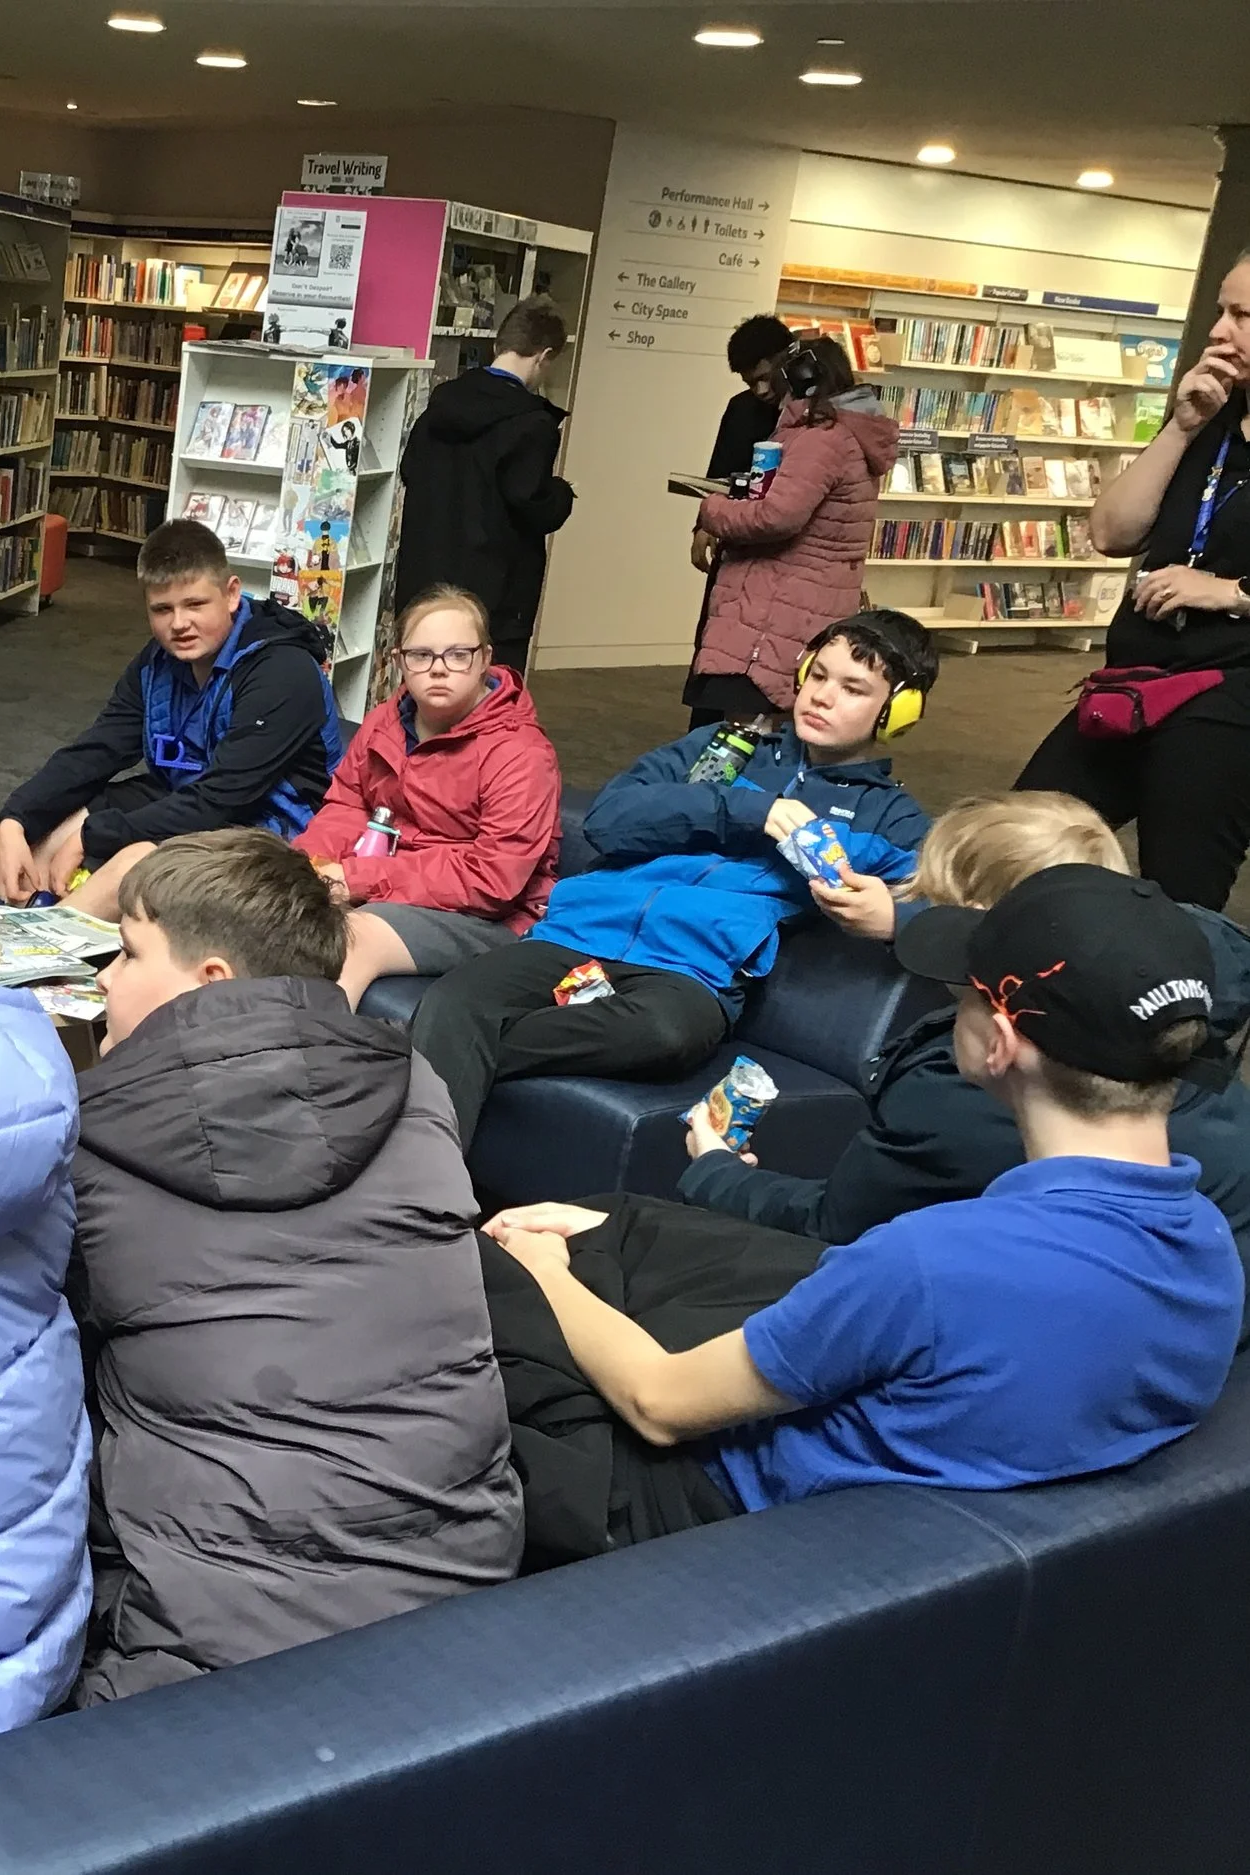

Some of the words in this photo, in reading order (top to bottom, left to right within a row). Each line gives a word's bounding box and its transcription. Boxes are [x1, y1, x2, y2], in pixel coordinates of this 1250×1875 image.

[308, 159, 341, 175] Travel
[343, 160, 382, 180] Writing
[661, 186, 730, 208] Performance
[732, 196, 754, 211] Hall
[714, 222, 748, 239] Toilets
[718, 252, 743, 267] Café
[637, 272, 656, 287] The
[659, 275, 697, 294] Gallery
[632, 302, 654, 319] City
[655, 304, 688, 320] Space
[627, 330, 655, 347] Shop
[1129, 978, 1206, 1020] PAULTONS
